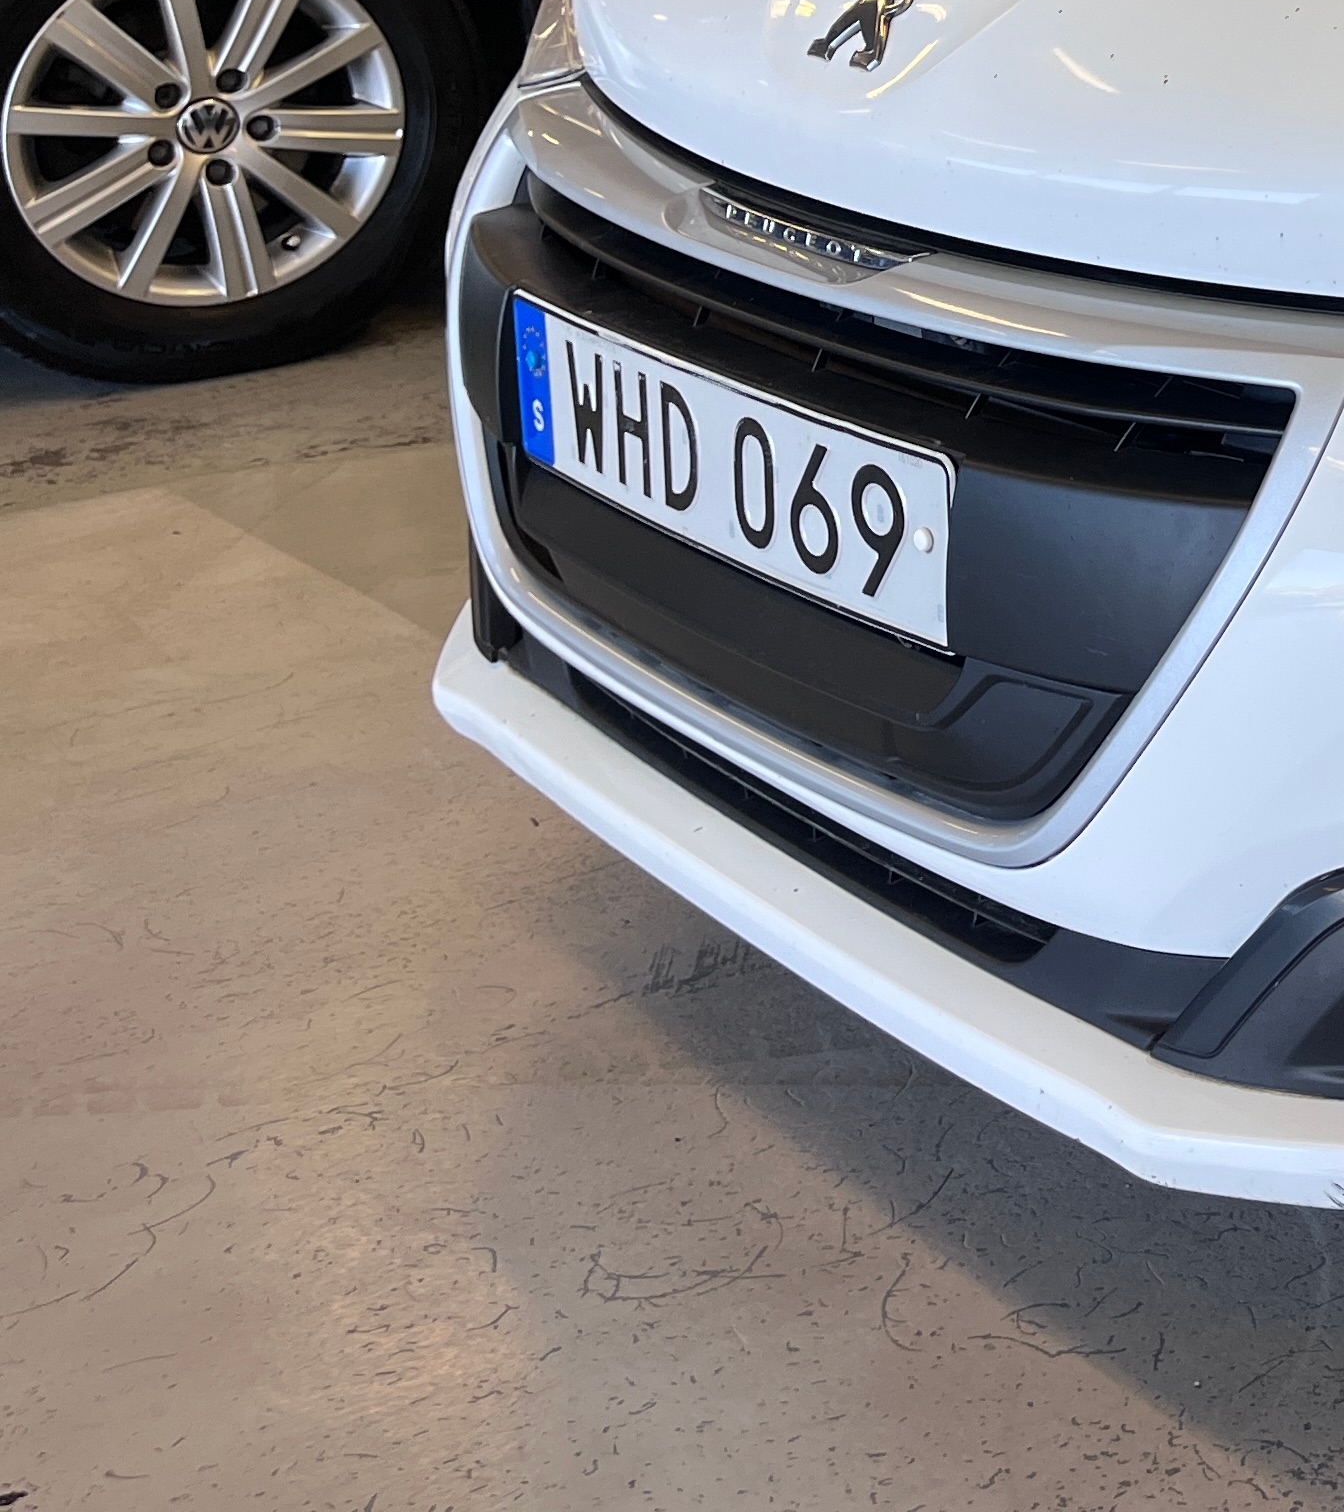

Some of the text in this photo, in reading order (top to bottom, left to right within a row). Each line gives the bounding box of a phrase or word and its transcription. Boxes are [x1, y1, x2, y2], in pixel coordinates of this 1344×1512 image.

[725, 203, 863, 263] PEUGEOT
[532, 398, 545, 432] S
[565, 339, 905, 598] WHD 069
